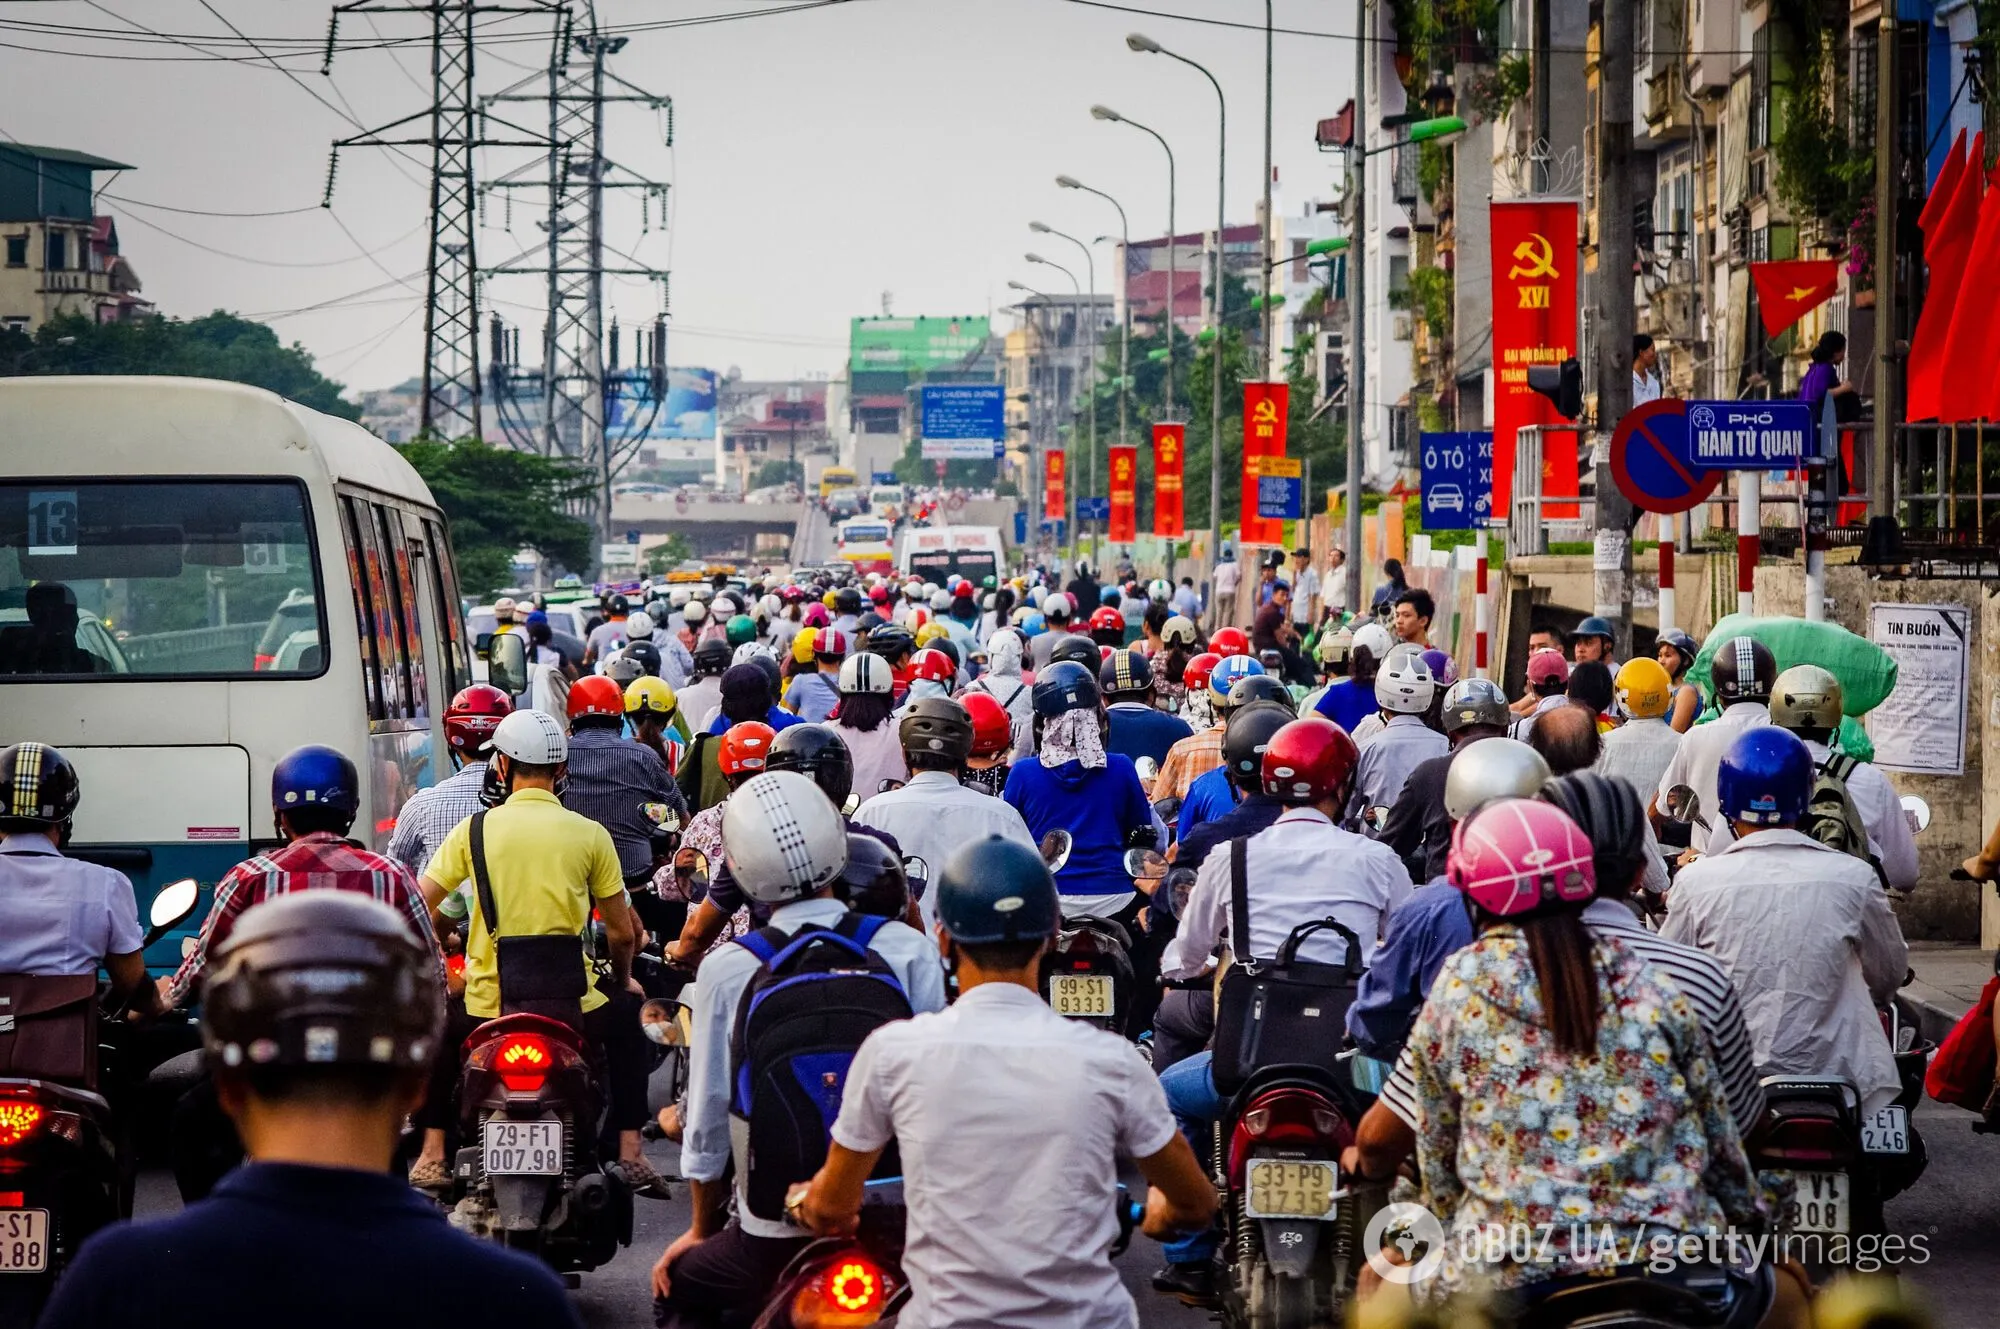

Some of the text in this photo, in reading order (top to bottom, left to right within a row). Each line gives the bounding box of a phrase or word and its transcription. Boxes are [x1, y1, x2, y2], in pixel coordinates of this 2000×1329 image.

[1518, 286, 1549, 308] XVI
[1729, 411, 1773, 424] PHỐ
[1698, 425, 1803, 460] HÀM TỬ QUAN
[1425, 445, 1464, 469] Ô TÔ
[28, 501, 76, 545] 13
[1888, 622, 1903, 635] TIN
[1061, 997, 1104, 1013] 9333
[496, 1125, 549, 1147] 29-F1
[490, 1149, 557, 1171] 007.98
[1262, 1164, 1323, 1188] 33-P9
[1262, 1190, 1322, 1215] 1735
[0, 1241, 40, 1268] .88
